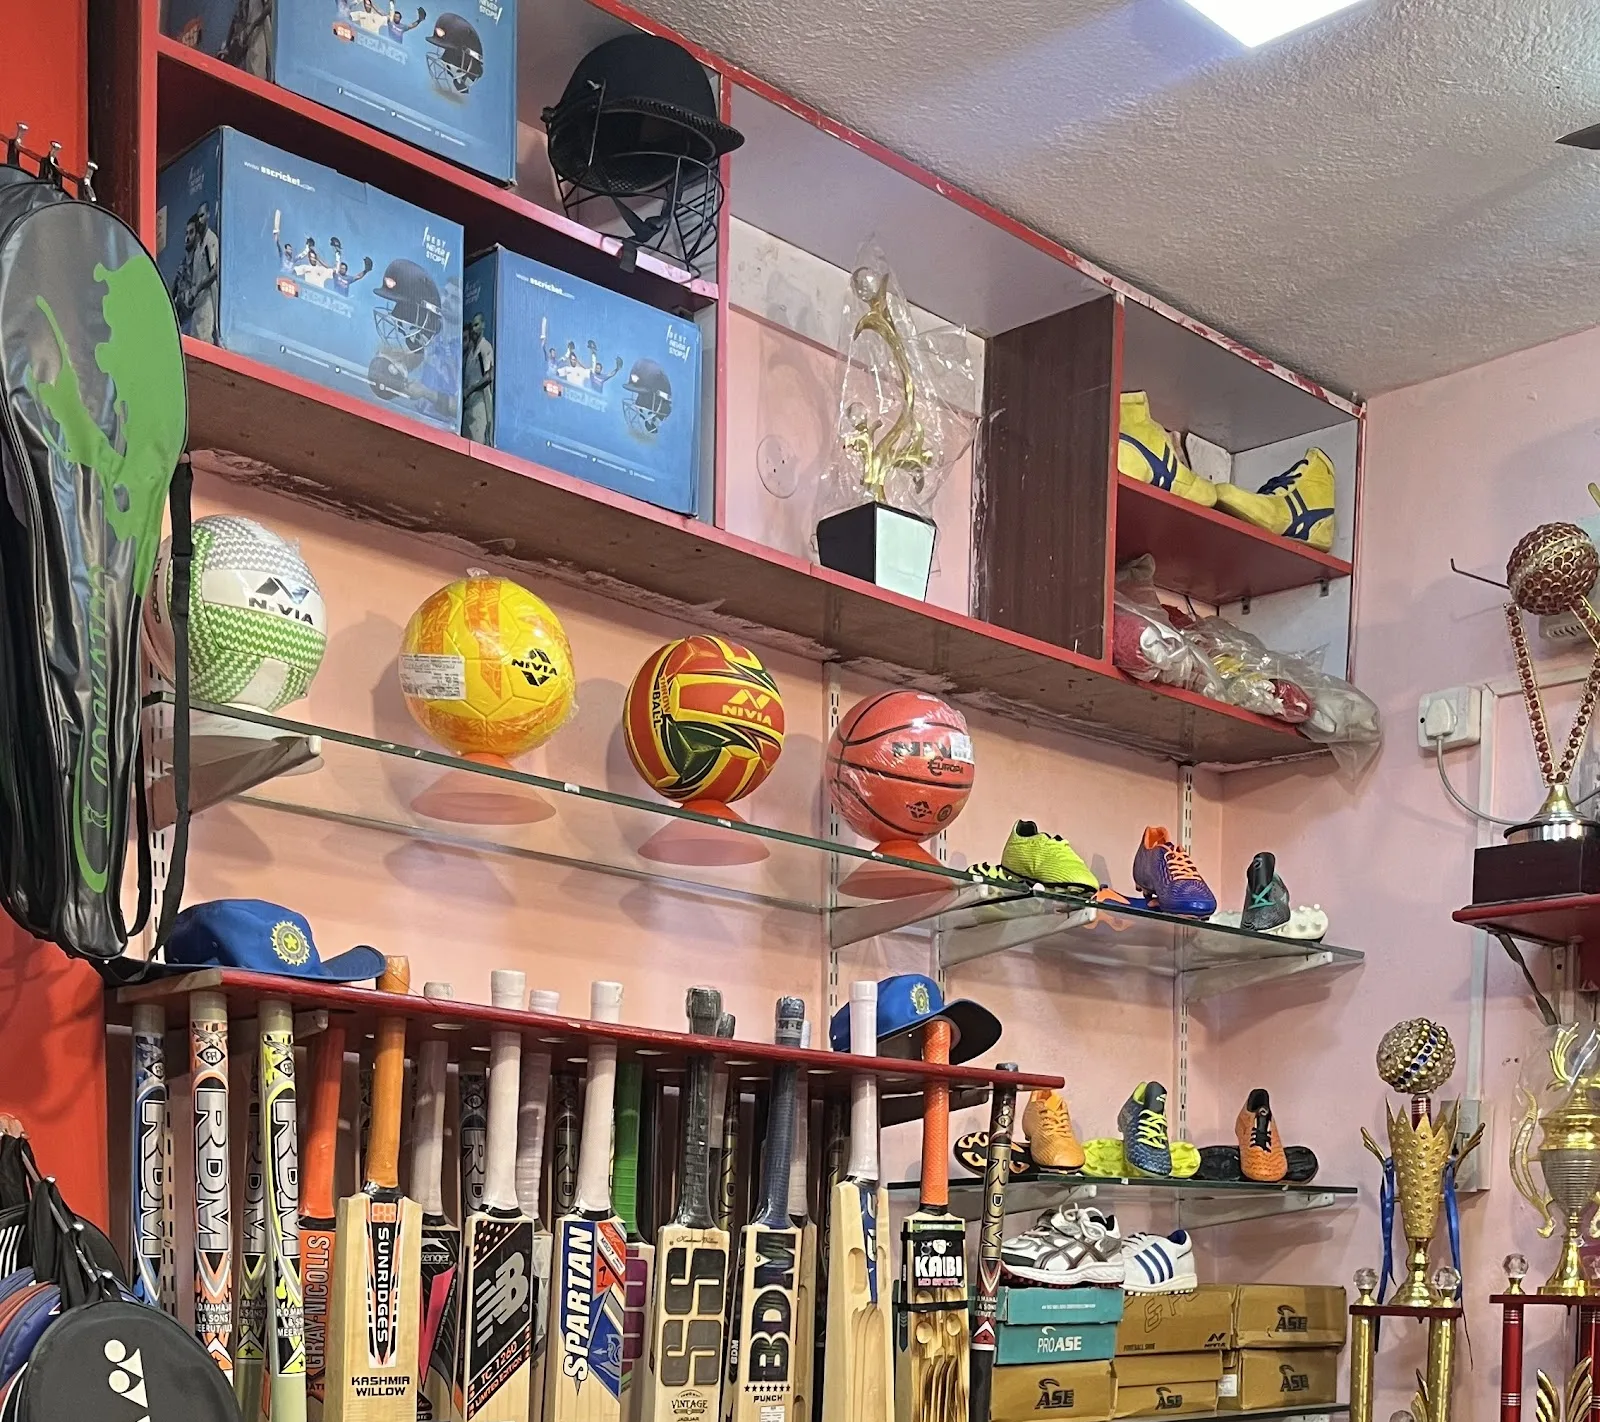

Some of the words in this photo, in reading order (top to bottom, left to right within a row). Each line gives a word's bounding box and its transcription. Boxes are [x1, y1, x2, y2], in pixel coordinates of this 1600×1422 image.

[511, 658, 558, 676] NIVIA
[652, 689, 661, 729] BALL
[722, 704, 772, 727] NIVIA
[195, 1088, 231, 1253] RDM
[272, 1099, 301, 1258] RDM
[982, 1146, 1009, 1259] RDM
[421, 1254, 450, 1265] zenger
[377, 1227, 390, 1343] SUNRIDGES
[563, 1224, 593, 1382] SPARTAN
[748, 1231, 797, 1382] BDM
[208, 1314, 228, 1323] SONS
[1275, 1316, 1308, 1333] ASE
[481, 1366, 493, 1385] TC
[495, 1340, 518, 1370] 1260
[730, 1339, 739, 1365] BDM
[352, 1376, 410, 1386] KASHMIR
[356, 1386, 406, 1397] WILLOW
[475, 1378, 500, 1407] LIMITED
[499, 1354, 523, 1383] EDITION
[1280, 1374, 1309, 1393] ASE
[671, 1399, 708, 1409] VINTAGE
[753, 1395, 783, 1403] PUNCH
[1034, 1389, 1075, 1411] ASE
